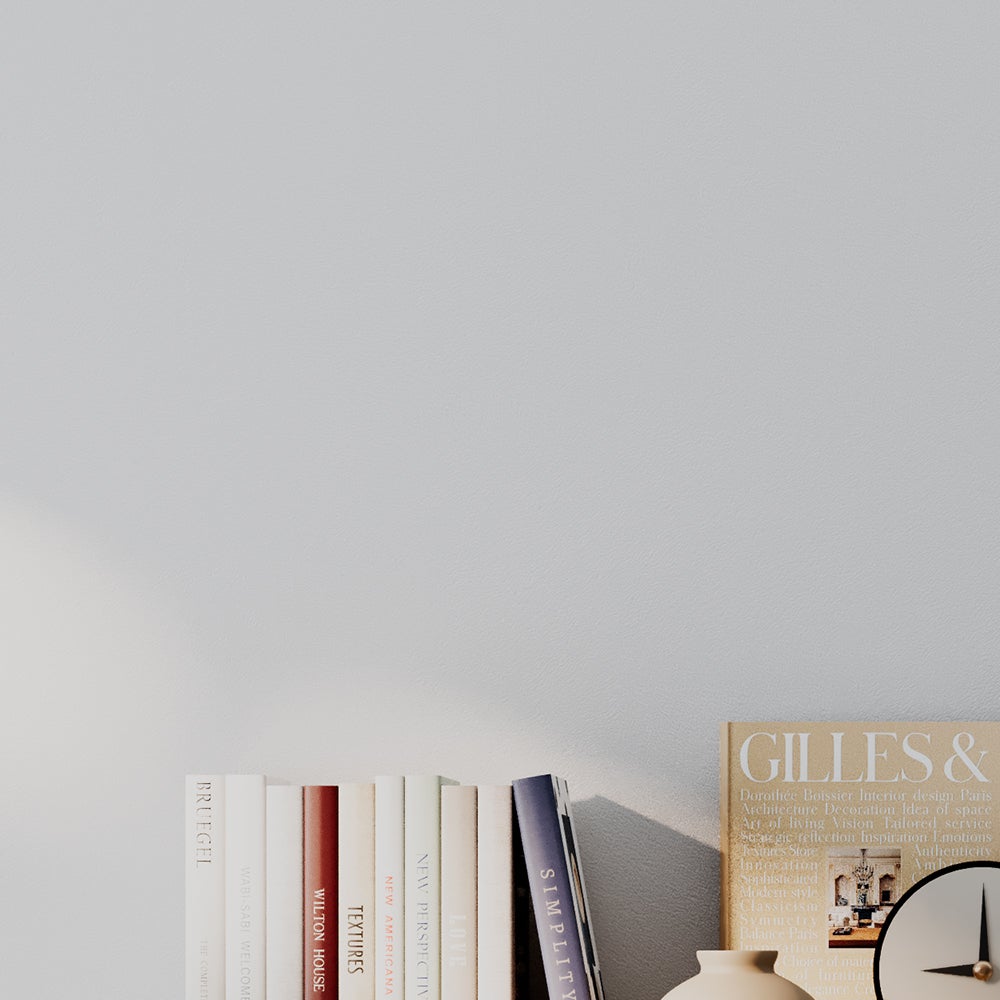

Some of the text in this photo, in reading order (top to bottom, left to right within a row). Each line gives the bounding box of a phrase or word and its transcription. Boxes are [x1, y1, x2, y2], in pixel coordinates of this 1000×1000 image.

[739, 731, 992, 784] GILLES &
[742, 802, 993, 818] Architecture Decoration Idea of space
[803, 788, 854, 801] Boissier
[861, 788, 907, 801] Interior
[912, 788, 954, 805] design
[961, 788, 993, 801] Paris
[196, 782, 211, 868] BRUEGEL
[742, 816, 993, 831] Art of living Vision Tailored service
[798, 830, 855, 843] reflection
[861, 830, 928, 845] Inspiration
[933, 830, 993, 843] Emotions
[913, 843, 993, 858] Authenticity
[416, 853, 429, 894] NEW
[313, 888, 326, 992] WILTON HOUSE
[347, 905, 364, 974] TEXTURES
[384, 875, 393, 996] NEW AMERICANA
